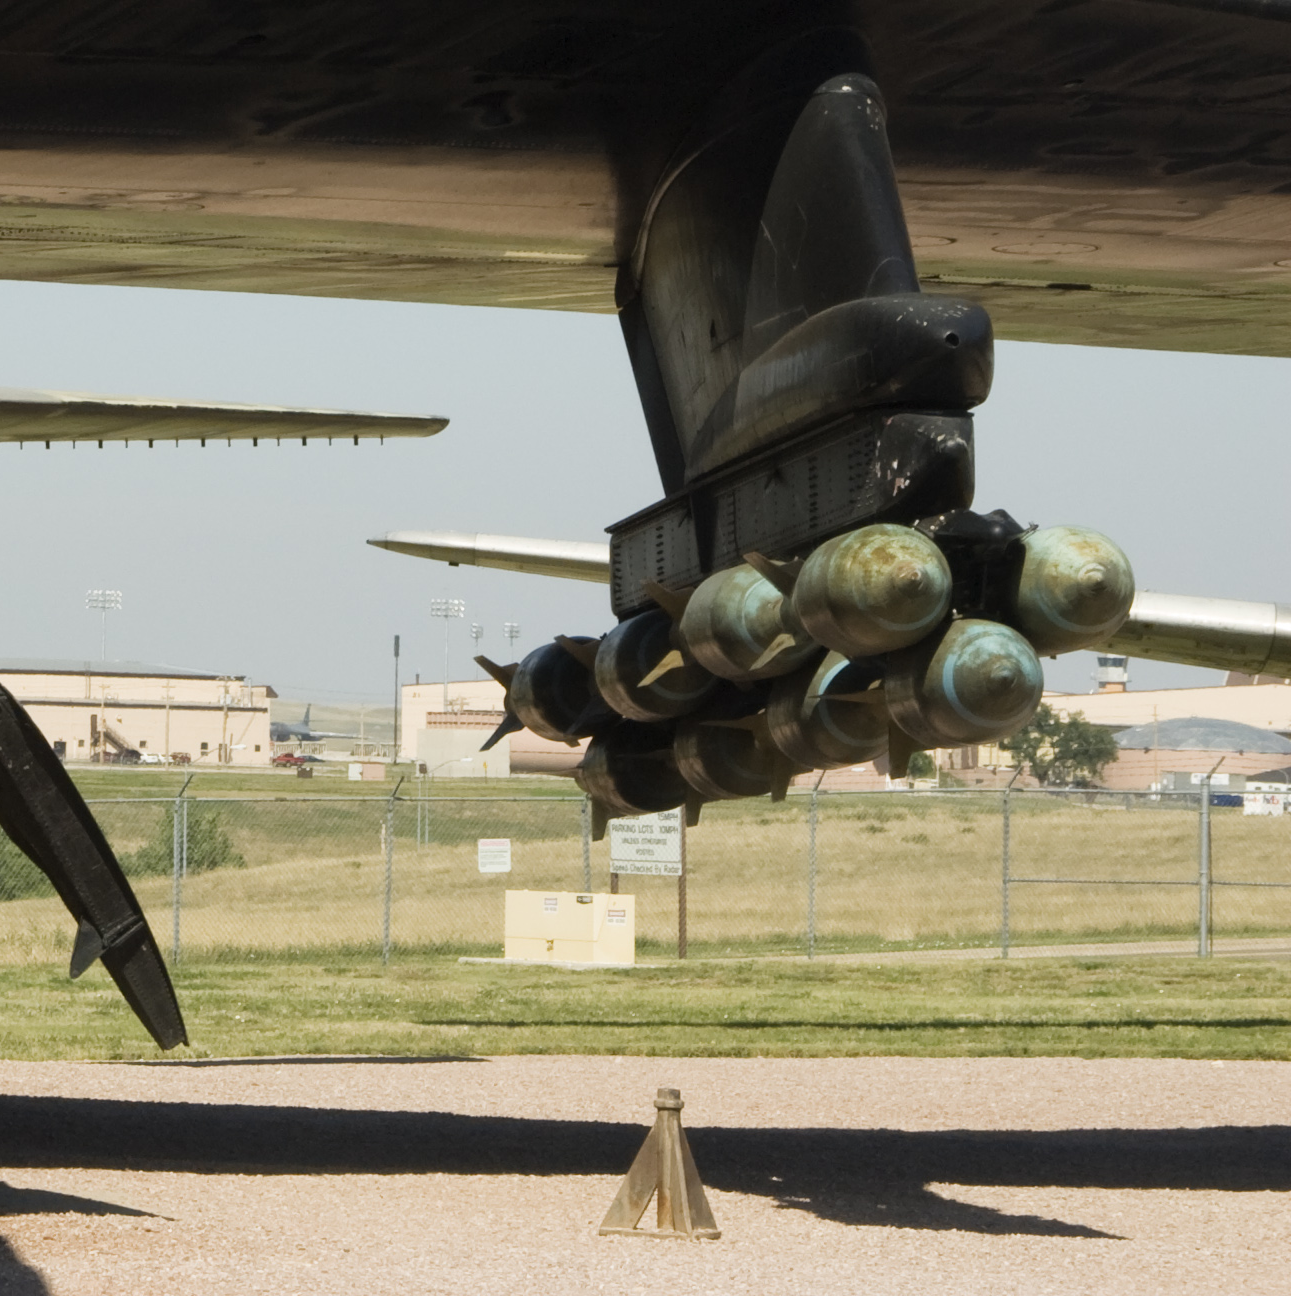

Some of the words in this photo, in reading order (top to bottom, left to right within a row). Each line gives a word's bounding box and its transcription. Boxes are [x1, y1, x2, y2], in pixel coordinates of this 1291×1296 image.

[612, 824, 636, 833] PARKING
[639, 825, 654, 834] LOTS
[659, 825, 678, 835] 10MPH
